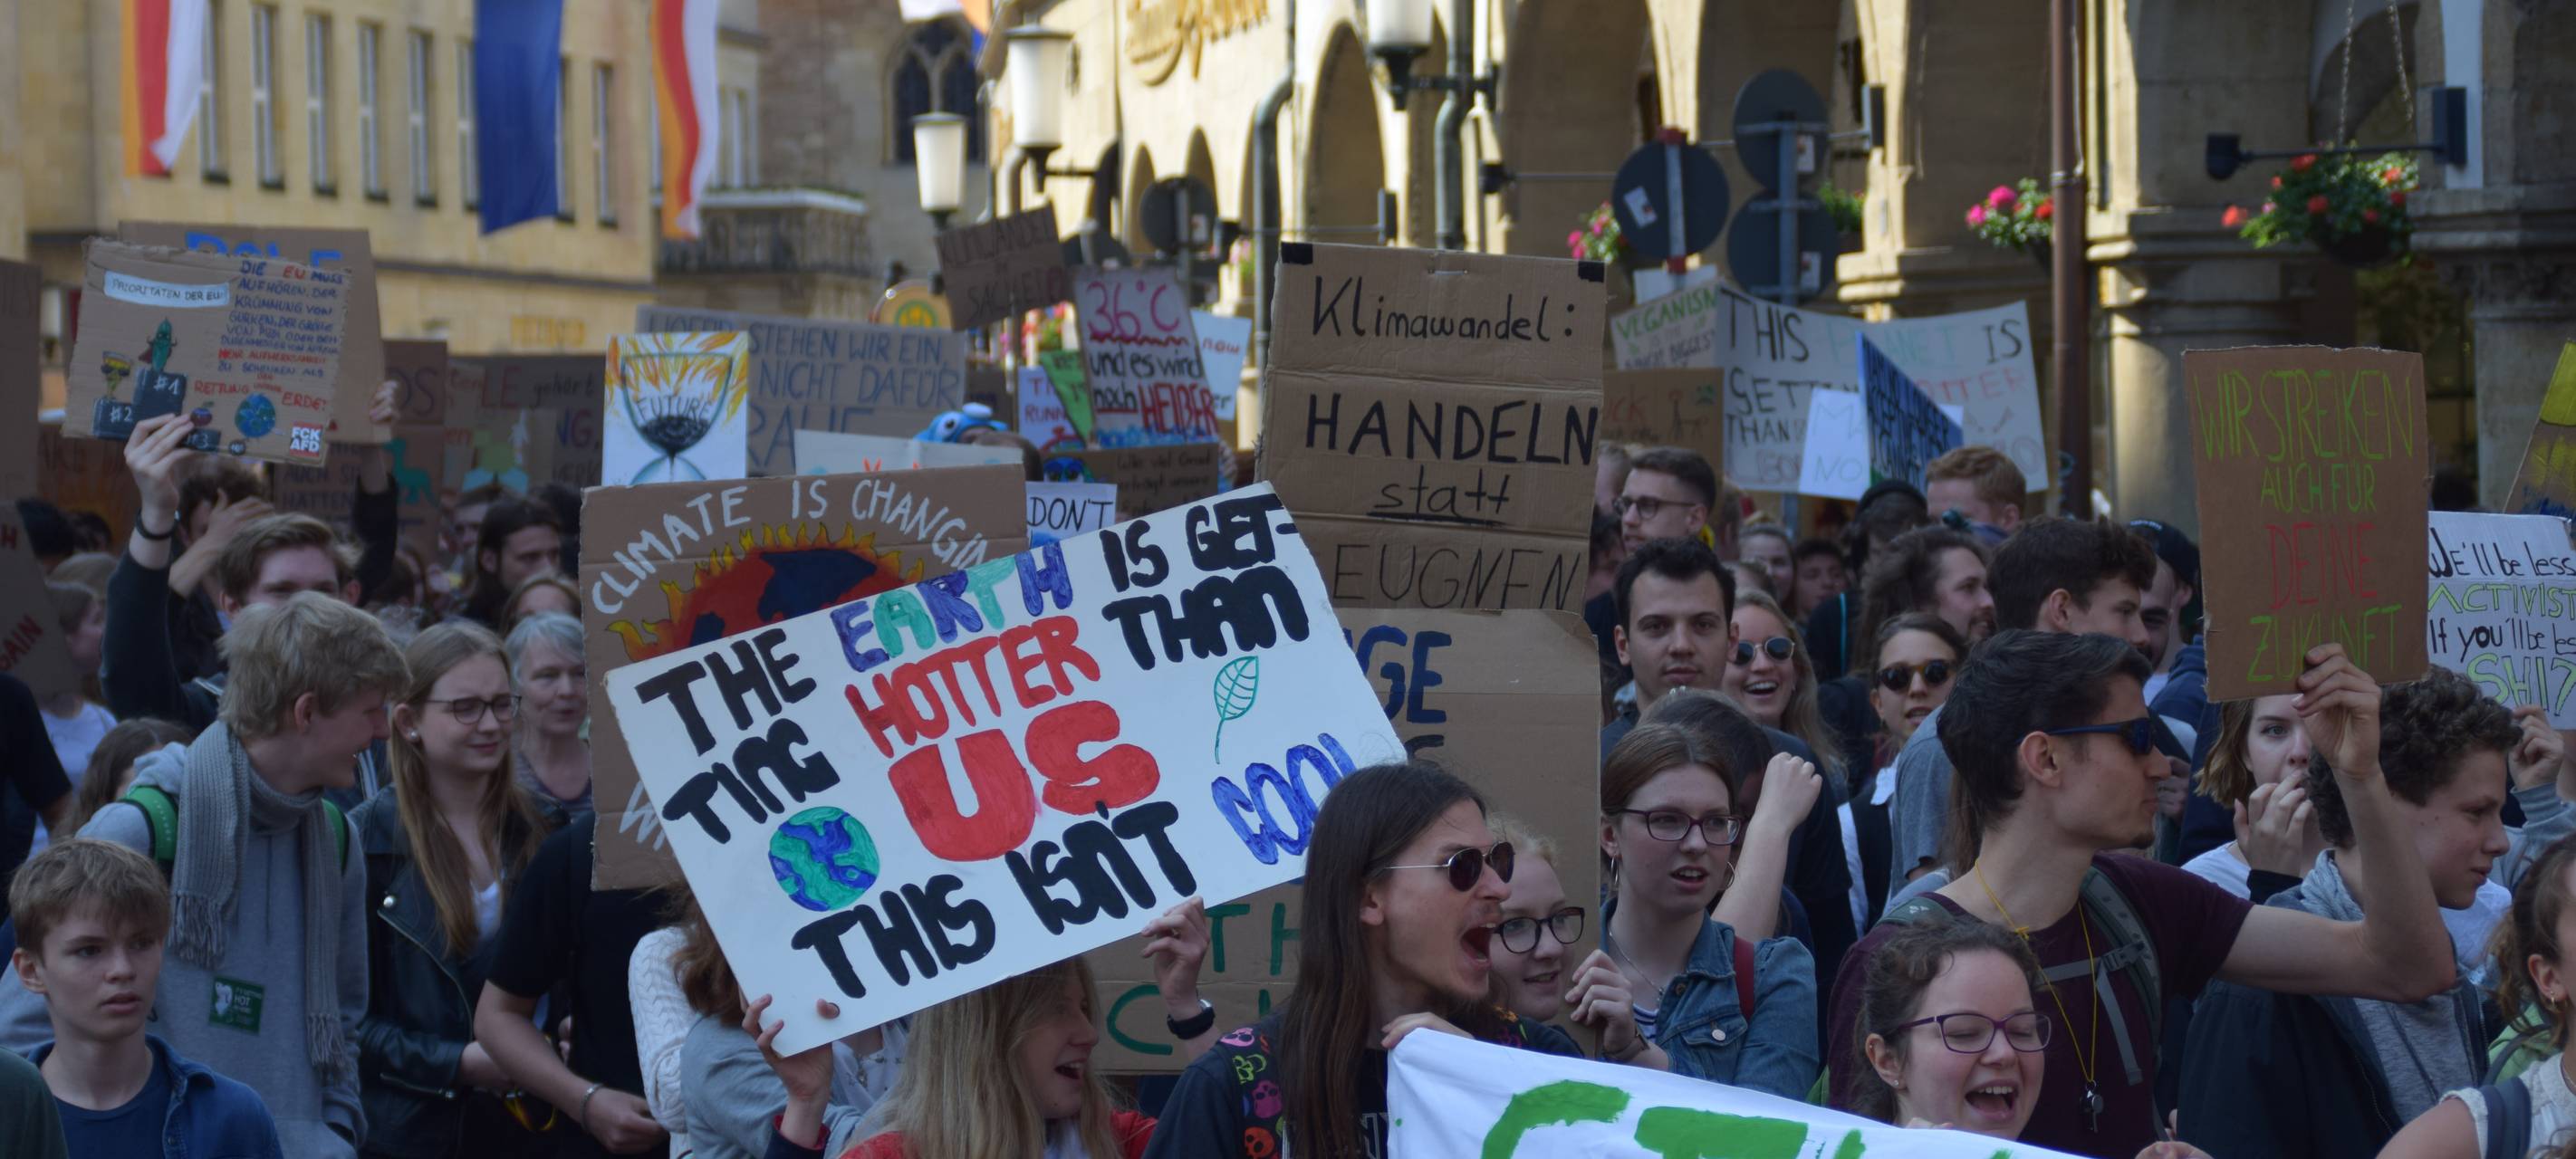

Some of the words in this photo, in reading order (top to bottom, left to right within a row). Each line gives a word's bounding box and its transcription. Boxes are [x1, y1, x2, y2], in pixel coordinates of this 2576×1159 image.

[239, 259, 267, 277] DIE
[282, 264, 305, 281] EU
[310, 270, 343, 285] MUSS
[184, 291, 205, 302] DER
[1086, 280, 1179, 337] 36°C
[749, 321, 837, 359] STEHEN
[849, 330, 892, 361] WIR
[1719, 287, 1811, 363] THIS
[1981, 318, 2024, 366] IS
[1090, 343, 1126, 378] und
[1129, 352, 1155, 379] es
[1156, 349, 1205, 378] wird
[152, 374, 178, 396] #1
[194, 379, 251, 396] RETTUNG
[758, 361, 847, 401] NICHT
[857, 365, 961, 410] DAFÜR
[1094, 384, 1138, 411] noch
[109, 407, 132, 425] #2
[634, 392, 715, 423] FUTURE
[1304, 391, 1600, 465] HANDELN
[2193, 374, 2260, 462] WIR
[2259, 369, 2414, 464] STREIKEN
[289, 439, 321, 454] AFD
[291, 426, 322, 442] FCK
[1372, 463, 1512, 516] statt
[2259, 464, 2324, 514] AUCH
[1026, 496, 1114, 532] DON'T
[591, 486, 751, 615] CLIMATE
[792, 480, 828, 519] IS
[2264, 522, 2379, 610] DEINE
[637, 627, 817, 756] THE
[830, 541, 1073, 673] EARTH
[1103, 529, 1170, 592] IS
[2429, 617, 2448, 655] If
[844, 615, 1102, 757] HOTTER
[1102, 565, 1311, 673] THAN
[889, 700, 1160, 863] US
[791, 874, 997, 1000] THIS
